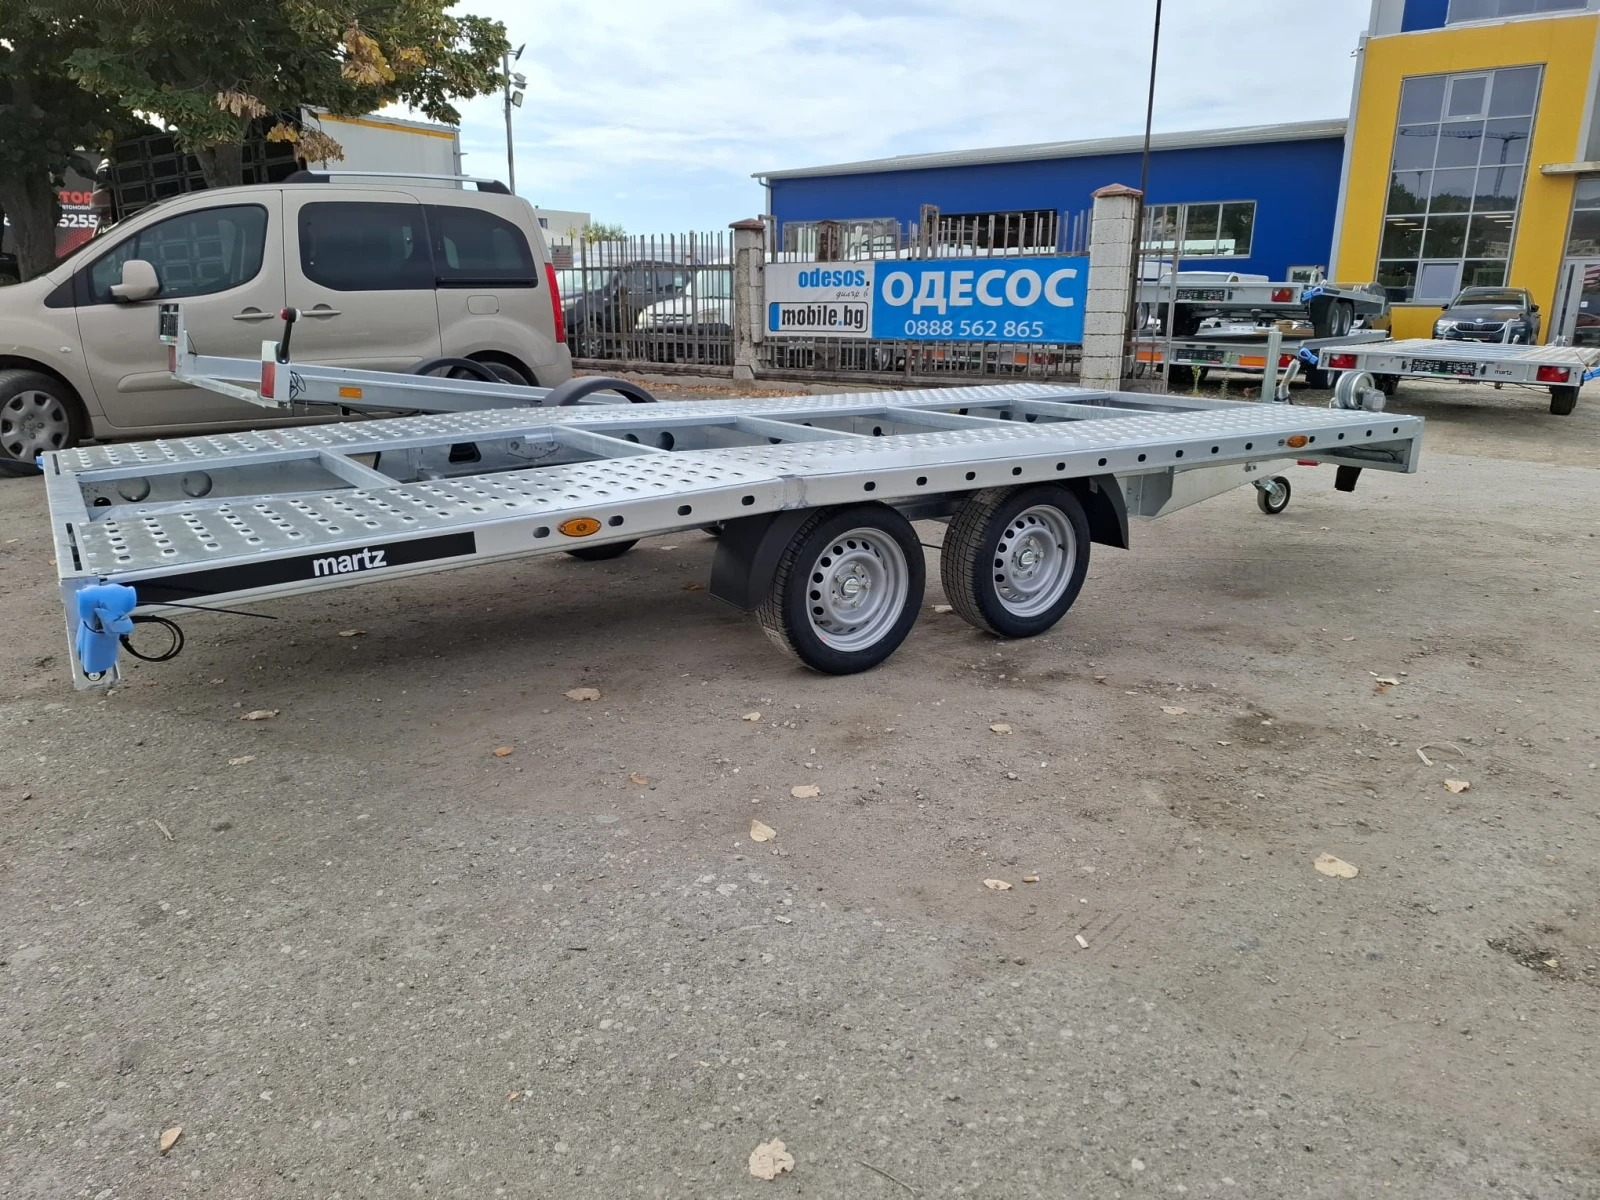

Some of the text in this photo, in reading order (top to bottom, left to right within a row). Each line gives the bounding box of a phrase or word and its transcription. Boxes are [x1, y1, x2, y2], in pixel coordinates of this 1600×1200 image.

[881, 268, 1078, 315] ОДЕСОС
[782, 305, 864, 329] mobile.bg
[904, 319, 1044, 338] 0888 562 865
[1494, 368, 1513, 376] martz
[312, 547, 388, 577] martz
